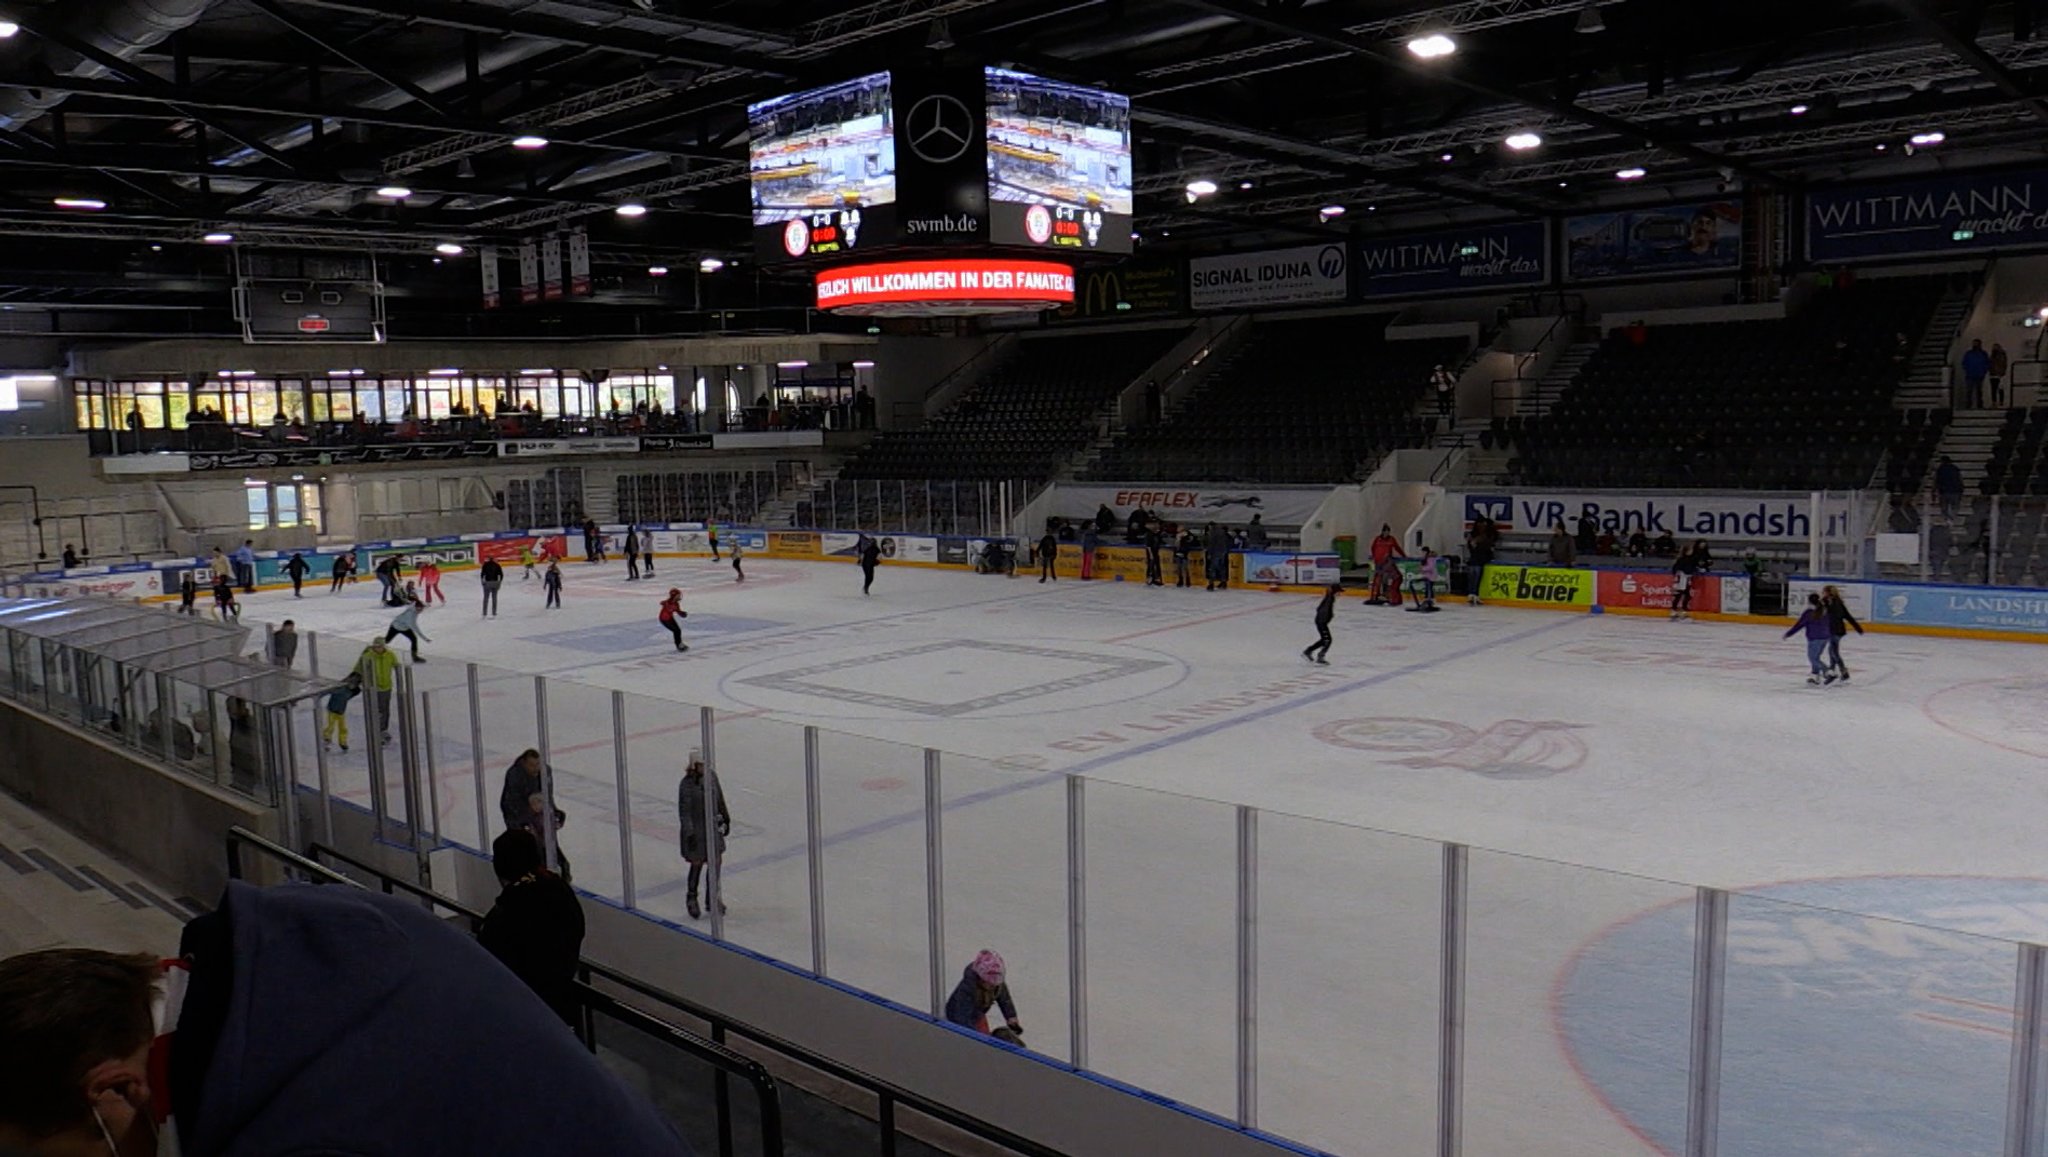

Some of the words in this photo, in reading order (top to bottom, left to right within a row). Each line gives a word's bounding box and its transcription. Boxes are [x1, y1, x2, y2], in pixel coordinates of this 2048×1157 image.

[1813, 183, 2032, 229] WITTMANN
[907, 213, 978, 234] swmb.de
[850, 271, 957, 294] WILLKOMMEN
[960, 271, 979, 289] IN
[981, 271, 1014, 289] DER
[1015, 271, 1065, 292] FANATEC
[1193, 266, 1254, 287] SIGNAL
[1257, 261, 1312, 282] IDUNA
[1521, 500, 1665, 533] VR-Bank
[1515, 567, 1580, 603] baier
